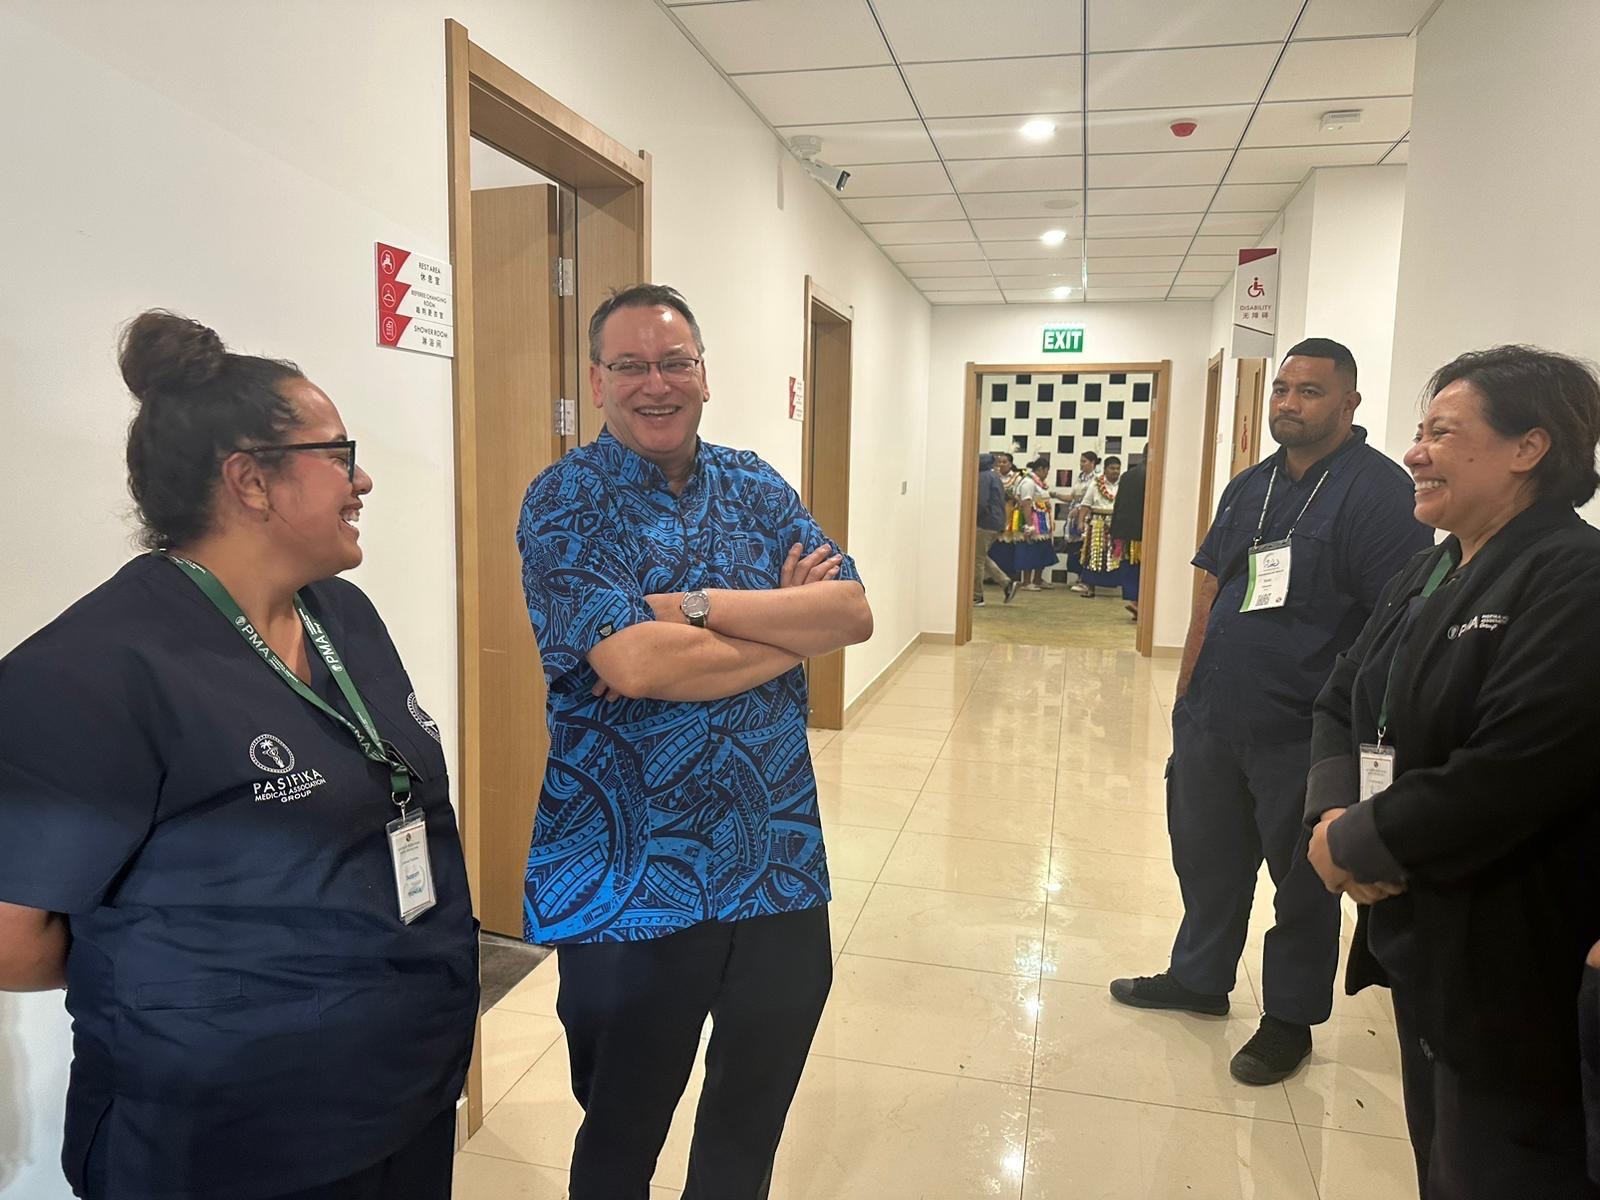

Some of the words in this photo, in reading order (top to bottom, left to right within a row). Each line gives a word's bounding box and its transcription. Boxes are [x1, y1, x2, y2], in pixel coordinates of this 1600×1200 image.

[418, 262, 429, 272] REST
[430, 265, 441, 274] AREA
[413, 325, 433, 335] SHOWER
[433, 328, 448, 338] ROOM
[1044, 331, 1083, 350] EXIT
[241, 623, 271, 659] PMA
[314, 635, 342, 664] PMA
[252, 768, 323, 795] PASIFIKA
[254, 790, 288, 803] MEDICAL
[288, 778, 327, 795] ASSOCIATION
[280, 789, 312, 803] GROUP
